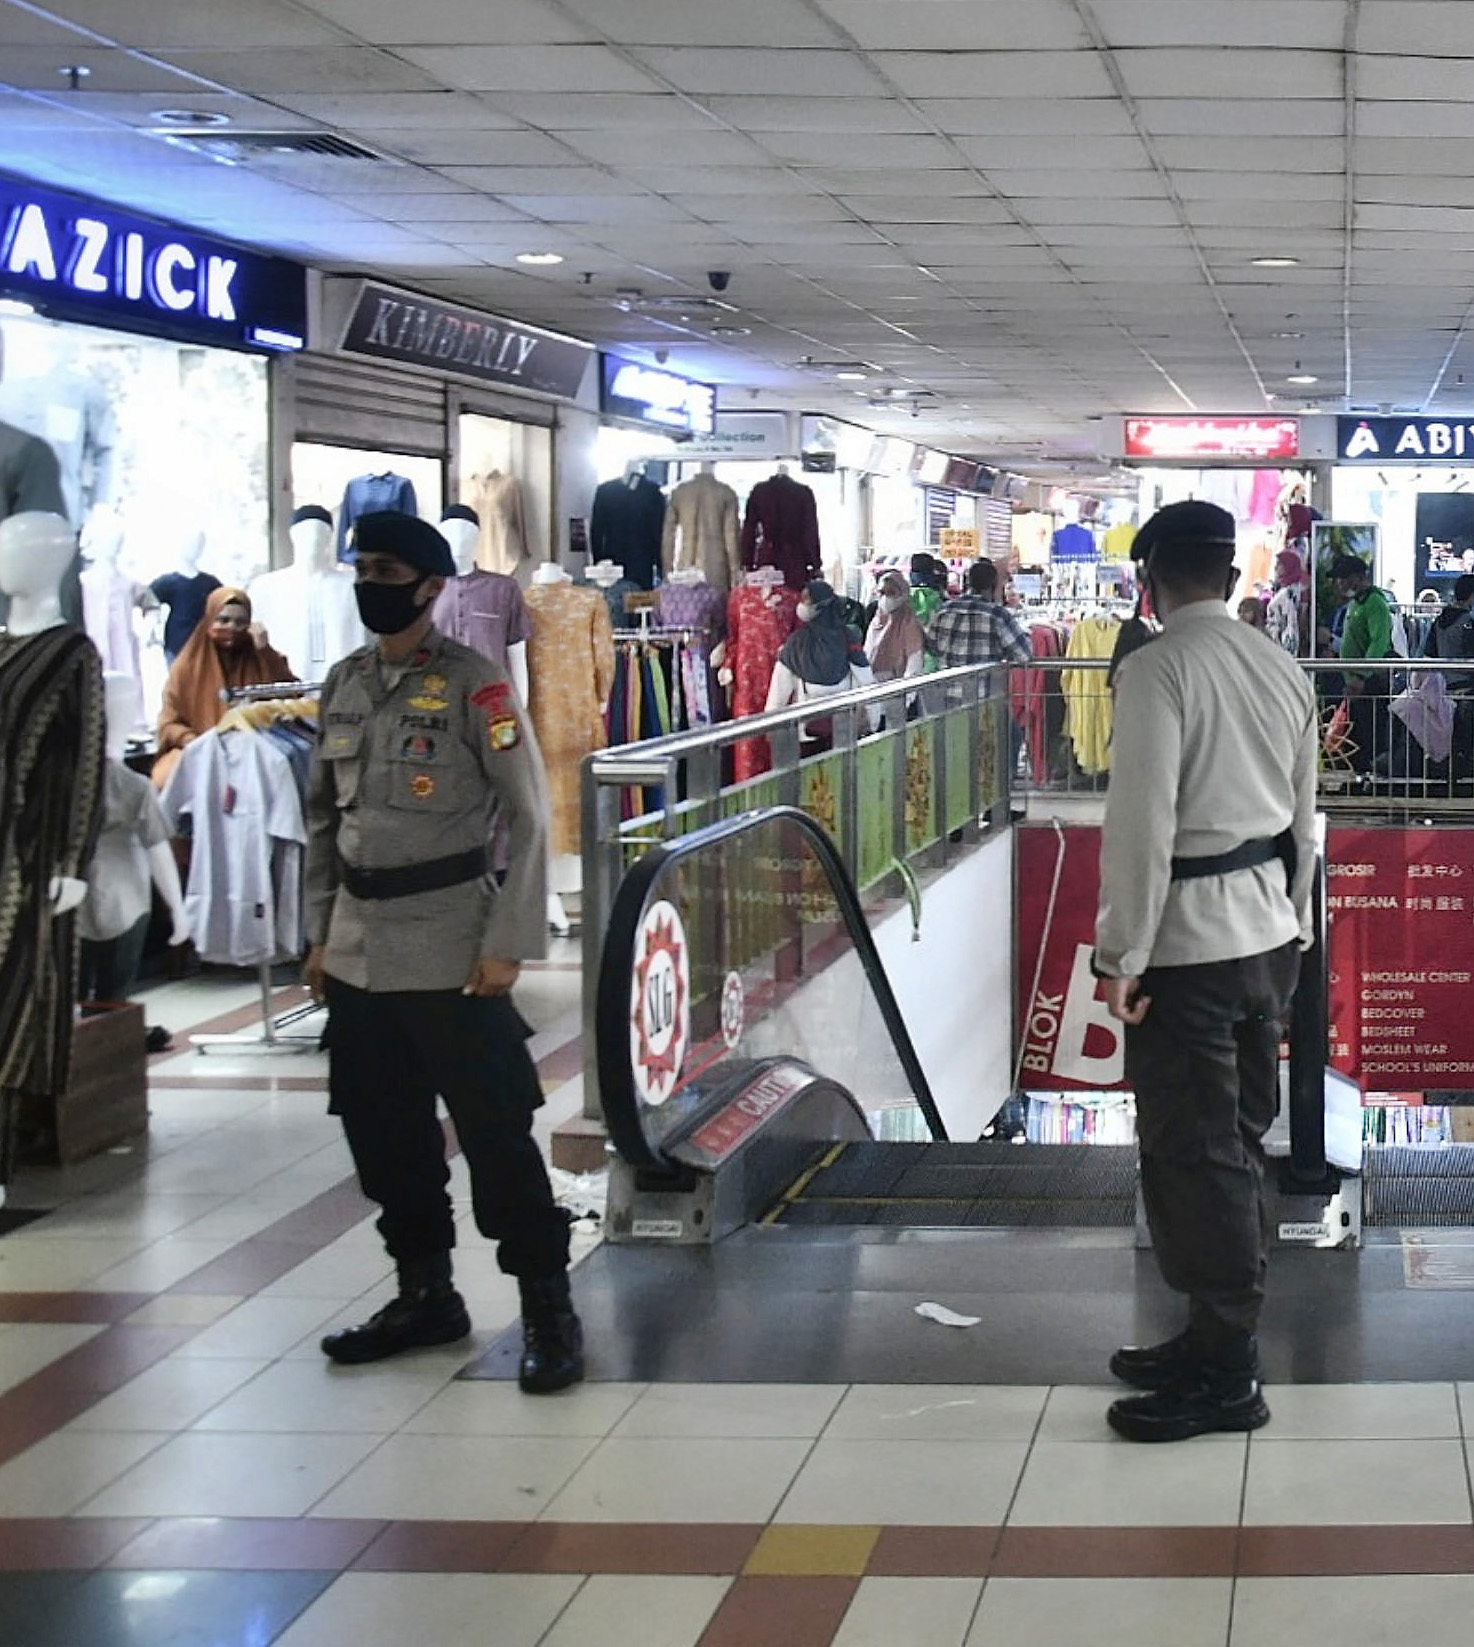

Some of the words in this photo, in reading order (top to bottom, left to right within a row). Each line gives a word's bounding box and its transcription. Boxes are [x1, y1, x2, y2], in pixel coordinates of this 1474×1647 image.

[8, 204, 237, 321] AZICK
[366, 298, 538, 376] KIMBERLY
[1344, 896, 1399, 909] BUSANA
[1361, 971, 1427, 983] WHOLESALE
[1428, 971, 1472, 983] CENTER
[1050, 942, 1125, 1086] B
[1361, 1007, 1426, 1019] BEDCOVER
[1023, 989, 1064, 1073] BLOK
[1361, 1026, 1416, 1037] BEDSHEET
[1361, 1044, 1412, 1056] MOSLEM
[1413, 1044, 1449, 1056] WEAR
[1361, 1061, 1420, 1073] SCHOOL'S
